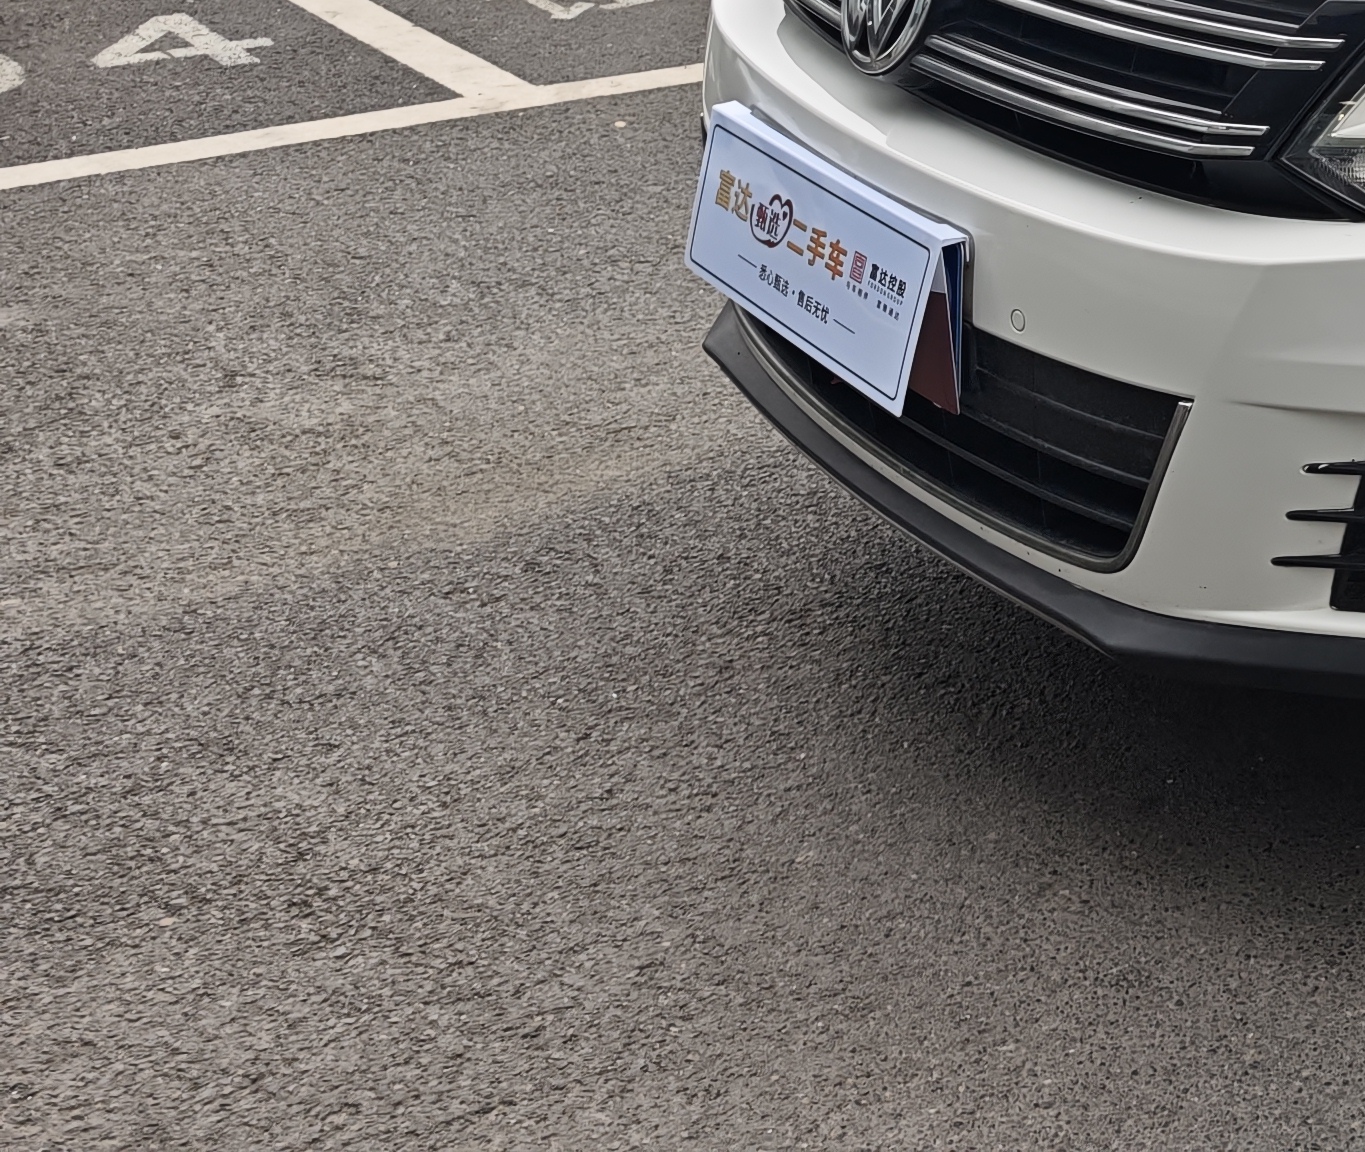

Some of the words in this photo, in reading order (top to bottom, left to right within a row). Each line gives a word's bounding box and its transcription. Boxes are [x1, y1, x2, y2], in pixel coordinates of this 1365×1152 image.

[714, 170, 752, 222] 富达
[786, 218, 848, 281] 二手车
[869, 263, 907, 299] 富达控股
